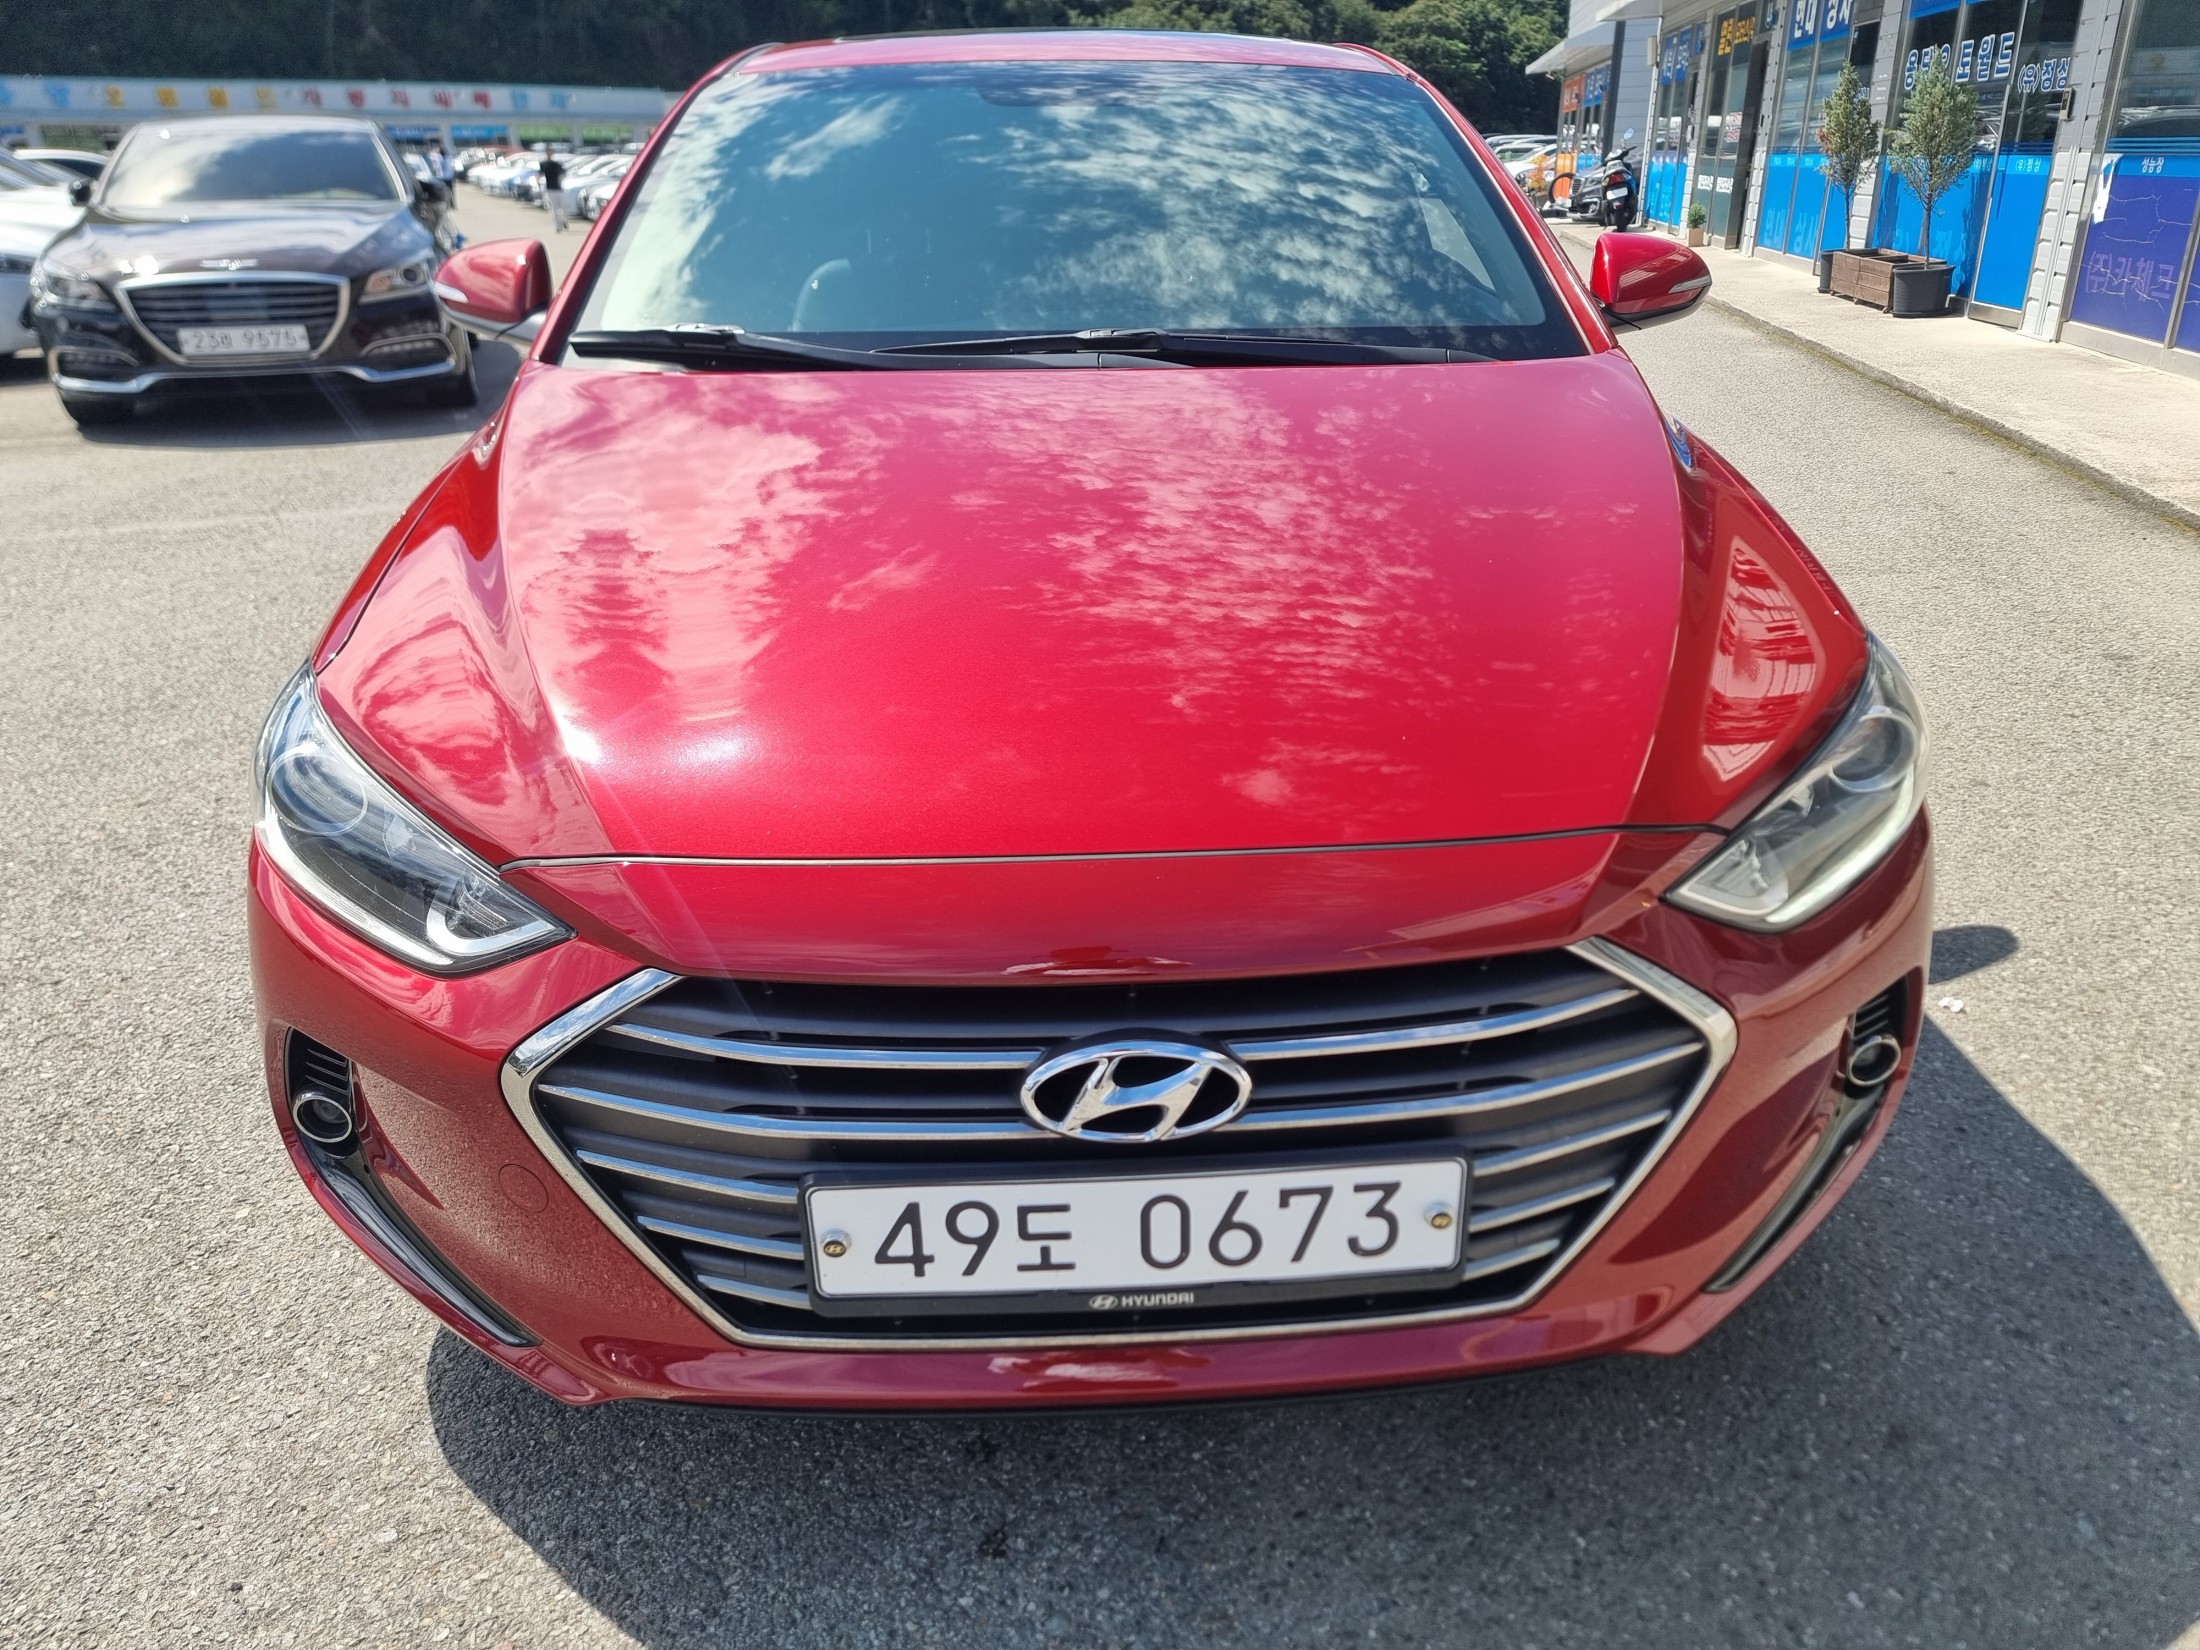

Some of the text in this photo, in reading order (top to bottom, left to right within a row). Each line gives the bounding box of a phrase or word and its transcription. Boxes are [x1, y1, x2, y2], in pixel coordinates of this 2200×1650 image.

[2142, 157, 2164, 173] 성능장
[873, 1180, 1402, 1278] 49도 0673
[1121, 1292, 1195, 1307] HYUNDAI
